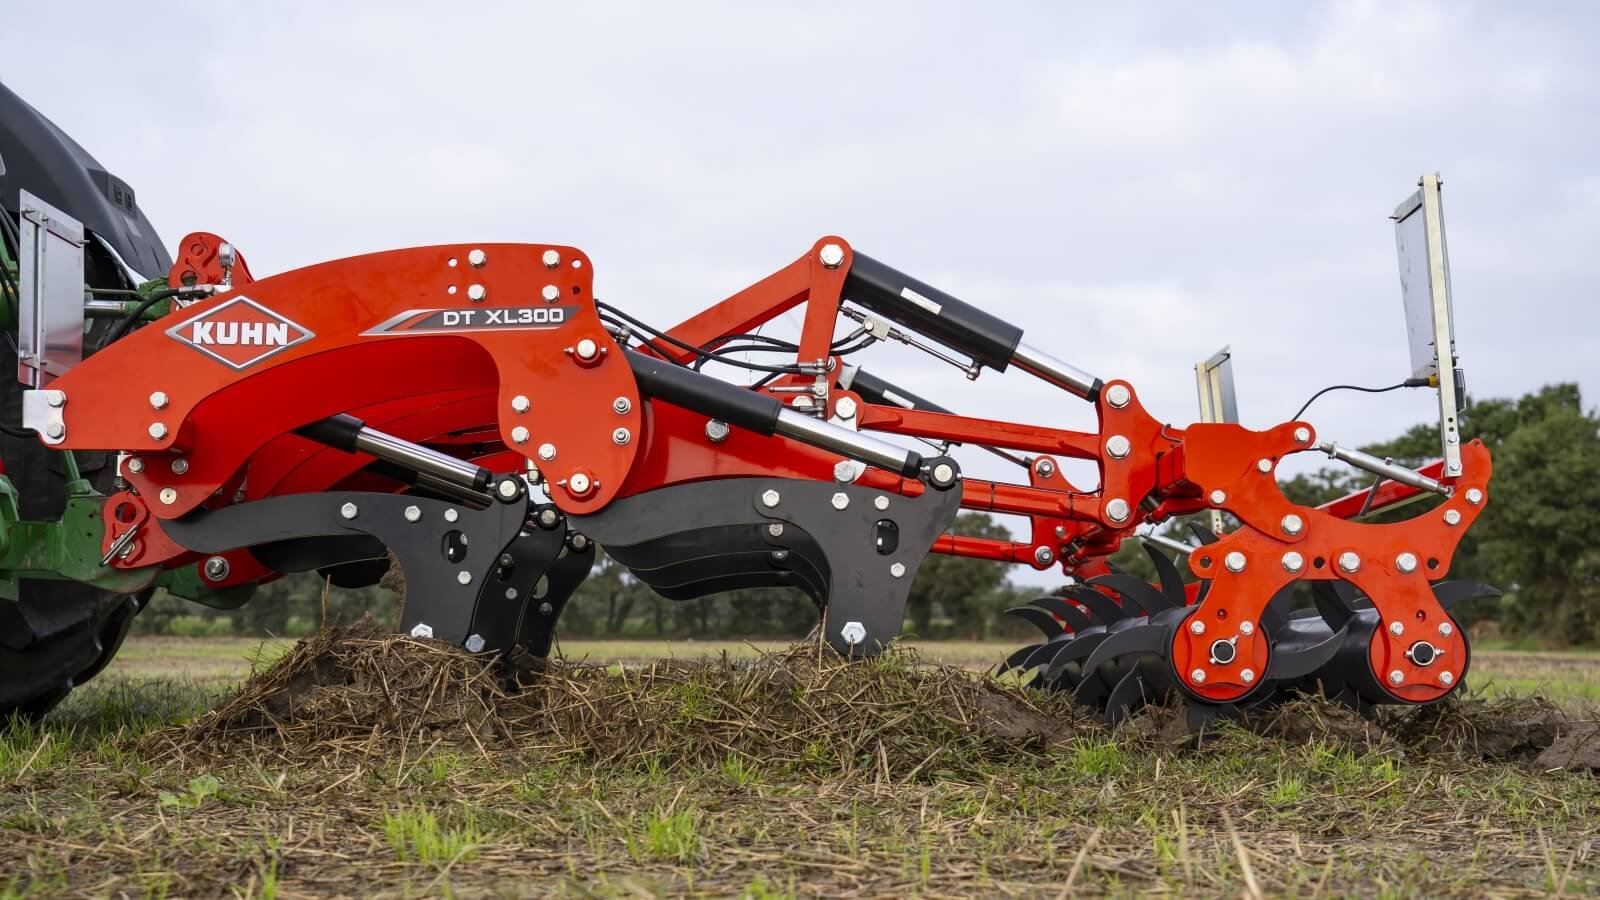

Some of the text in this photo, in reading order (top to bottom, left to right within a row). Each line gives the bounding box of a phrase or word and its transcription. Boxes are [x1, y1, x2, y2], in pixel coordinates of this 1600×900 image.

[443, 308, 564, 326] DT XL300
[192, 321, 288, 345] KUHN
